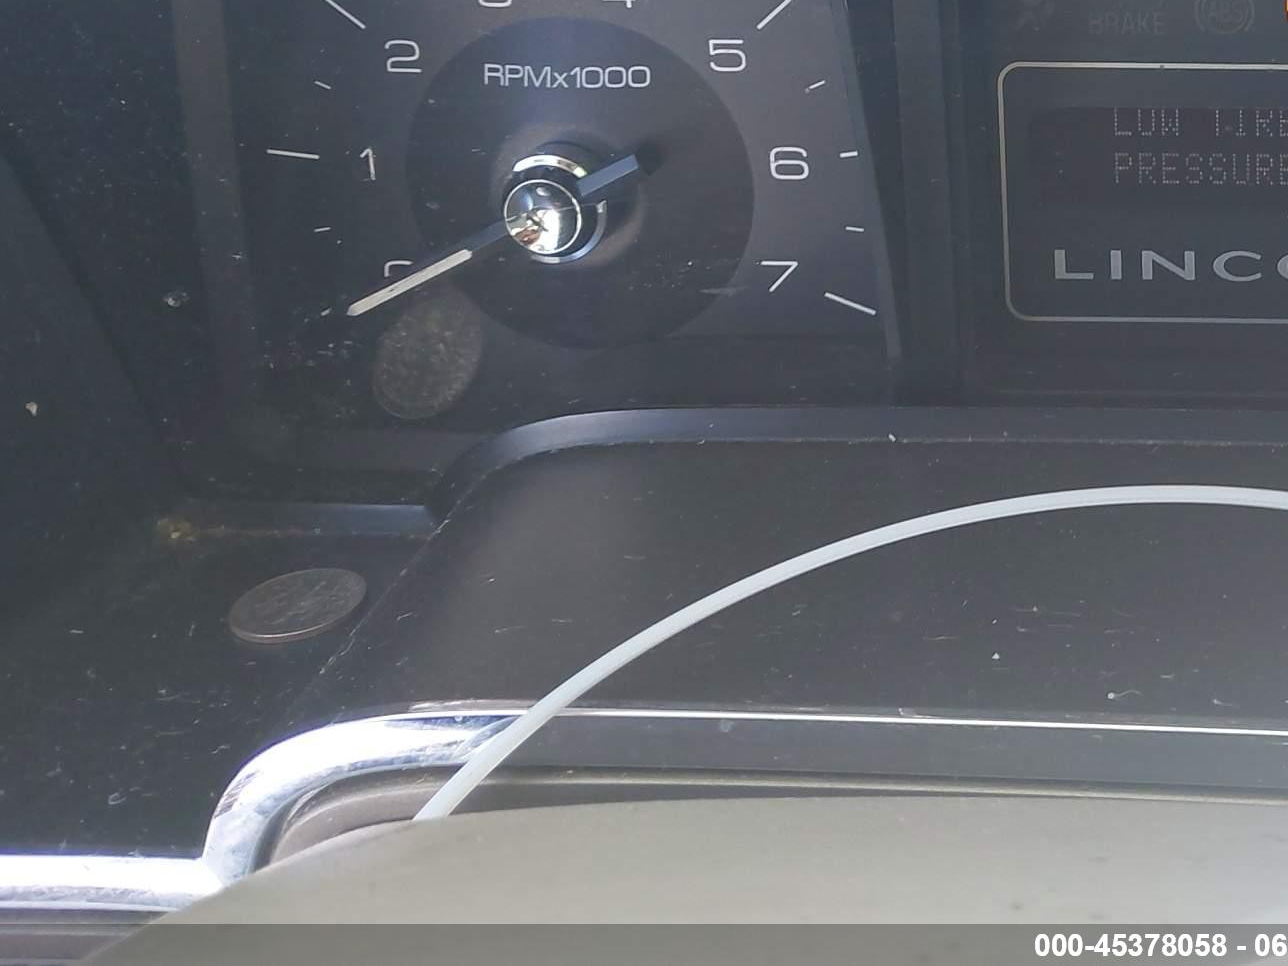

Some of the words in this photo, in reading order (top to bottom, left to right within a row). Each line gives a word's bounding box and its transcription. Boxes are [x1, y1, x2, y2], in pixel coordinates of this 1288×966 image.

[384, 39, 422, 73] 2
[708, 39, 747, 72] 5
[484, 63, 651, 89] RPMx1000
[359, 147, 376, 181] 1
[769, 146, 810, 180] 6
[760, 260, 799, 292] 7
